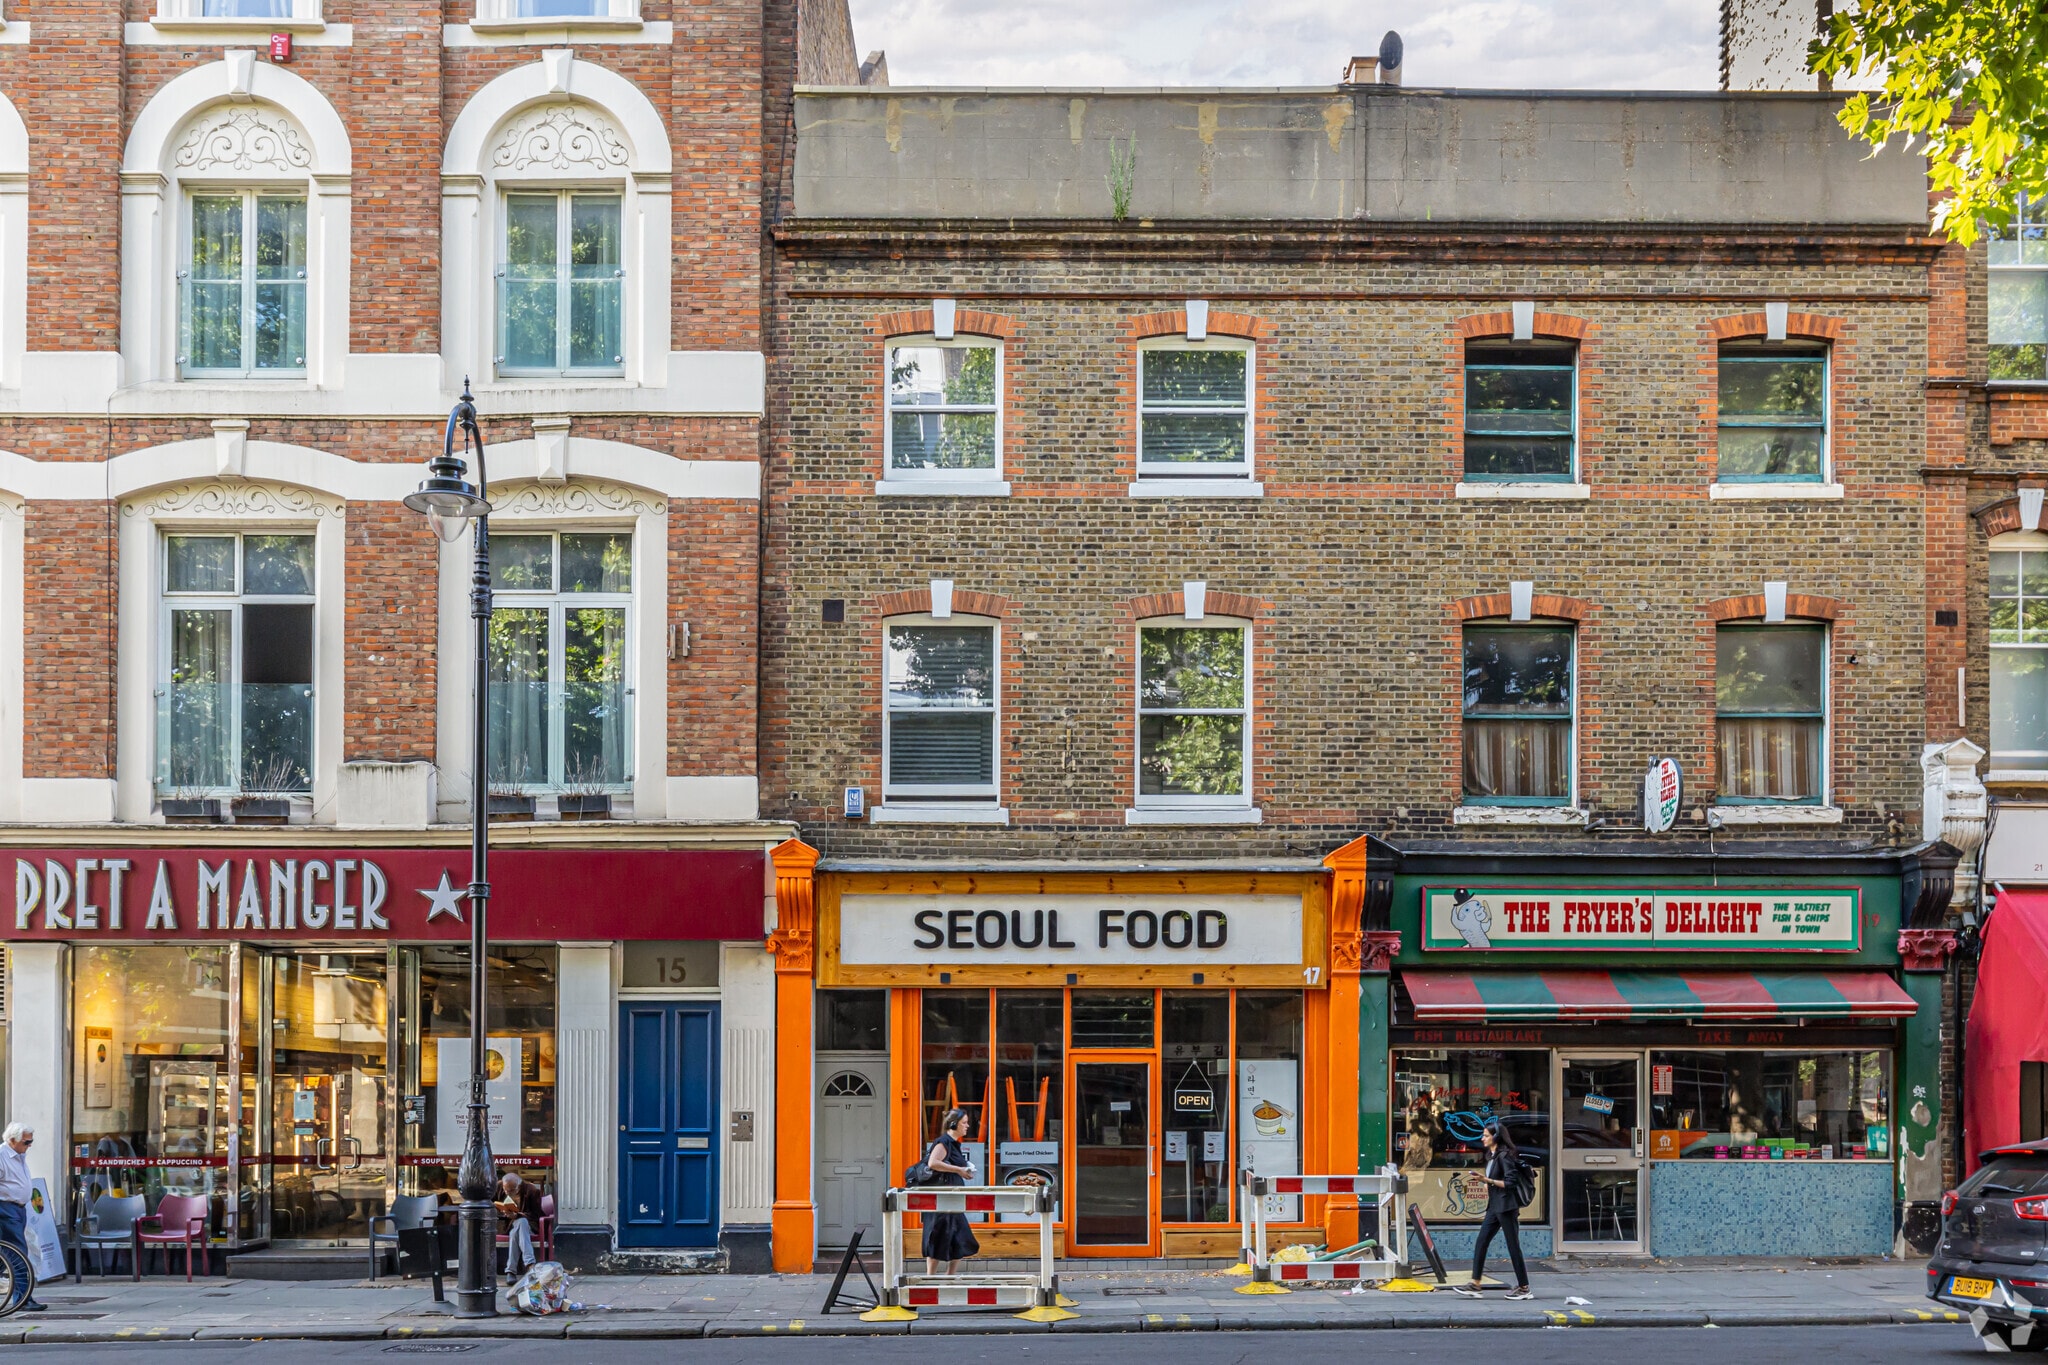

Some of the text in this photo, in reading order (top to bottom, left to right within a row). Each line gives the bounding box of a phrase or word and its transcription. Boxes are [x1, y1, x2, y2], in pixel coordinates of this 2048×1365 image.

[15, 858, 390, 930] PRET A MANGER
[1773, 903, 1831, 911] THE TASTIEST
[1504, 898, 1763, 933] THE FRYER'S DELIGHT
[1772, 914, 1830, 922] FISH & CHIPS
[1864, 912, 1881, 928] 19
[913, 909, 1228, 949] SEOUL FOOD
[1781, 925, 1821, 934] IN TOWN
[656, 957, 687, 983] 15
[1303, 967, 1321, 985] 17
[1414, 1030, 1542, 1041] FISH RESTAURANT
[1698, 1031, 1785, 1043] TAKE AWAY
[1178, 1096, 1210, 1105] OPEN
[1586, 1096, 1603, 1106] CLOSED
[1973, 1280, 1990, 1295] BHX
